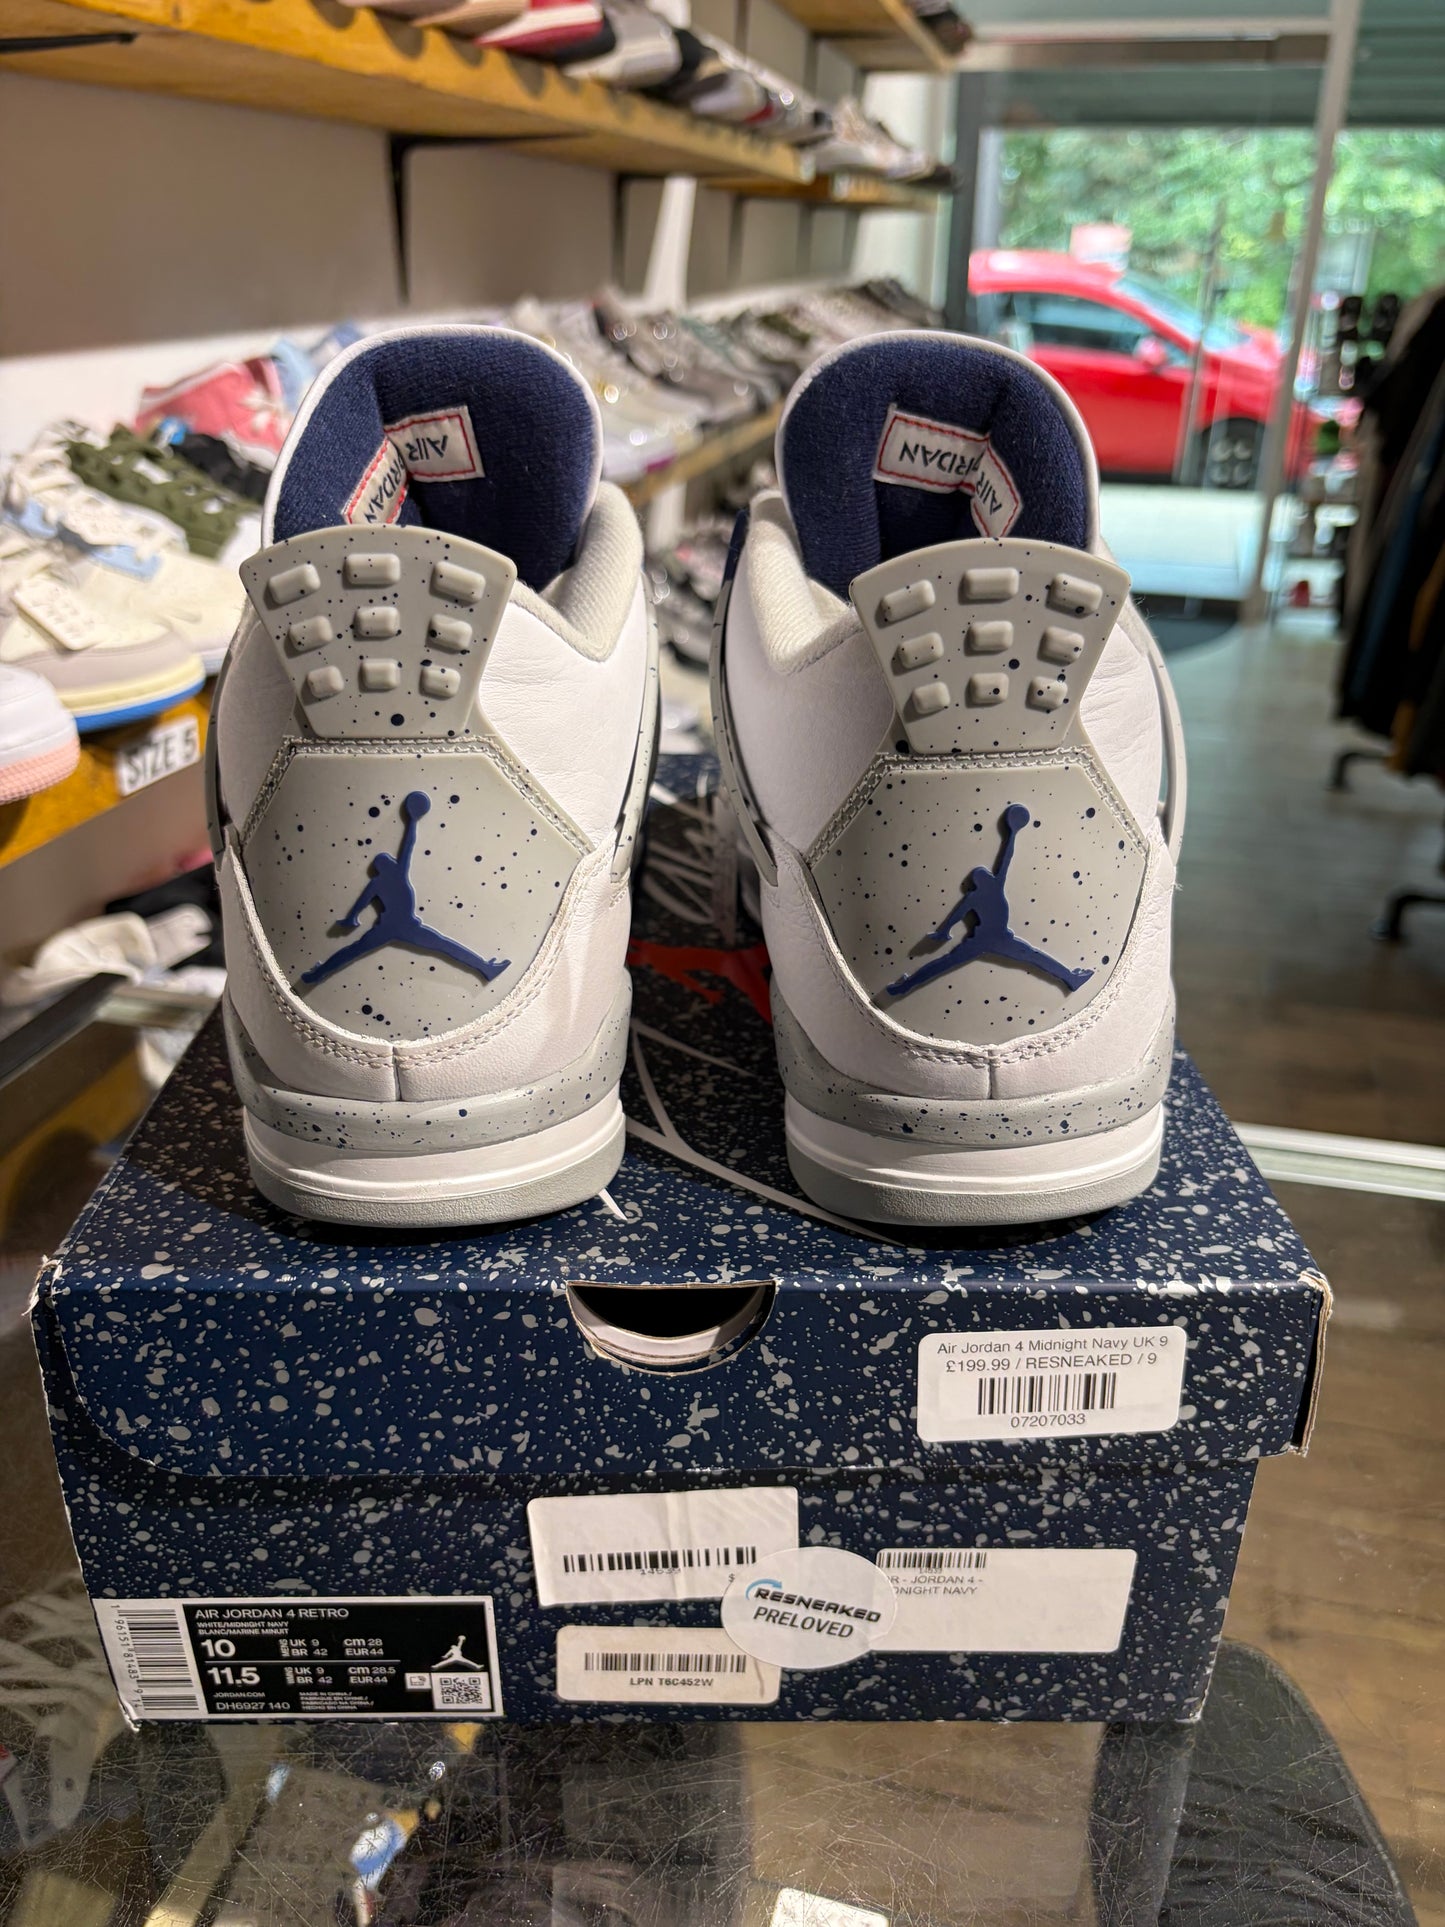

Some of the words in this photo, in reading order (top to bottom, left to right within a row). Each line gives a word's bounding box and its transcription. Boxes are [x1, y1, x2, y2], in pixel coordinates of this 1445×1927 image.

[405, 434, 448, 461] AIR
[976, 472, 1002, 515] AIR
[937, 1342, 958, 1354] Air
[964, 1342, 1010, 1354] Jordan
[1014, 1340, 1024, 1352] 4
[1028, 1338, 1088, 1352] Midnight
[1092, 1337, 1128, 1350] Navy
[1133, 1336, 1155, 1348] UK
[1159, 1336, 1168, 1346] 9
[946, 1358, 1010, 1372] £199.99
[1016, 1358, 1022, 1370] /
[1026, 1354, 1132, 1370] RESNEAKED
[1137, 1354, 1144, 1365] /
[1147, 1352, 1158, 1364] 9
[1010, 1414, 1086, 1428] 07207033
[911, 1576, 964, 1584] JORDAN
[943, 1586, 978, 1594] NAVY
[754, 1588, 882, 1622] RESNEAKED
[195, 1608, 220, 1619] AIR
[222, 1608, 282, 1618] JORDAN
[286, 1608, 296, 1618] 4
[298, 1608, 350, 1618] RETRO
[753, 1606, 854, 1638] PRELOVED
[200, 1638, 236, 1658] 10
[290, 1638, 306, 1647] UK
[311, 1638, 320, 1647] 9
[313, 1648, 328, 1656] 42
[208, 1666, 260, 1685] 11.5
[296, 1676, 313, 1684] BR
[318, 1676, 333, 1684] 42
[630, 1678, 654, 1686] LPN
[216, 1702, 266, 1710] DH6927
[268, 1702, 290, 1710] 140
